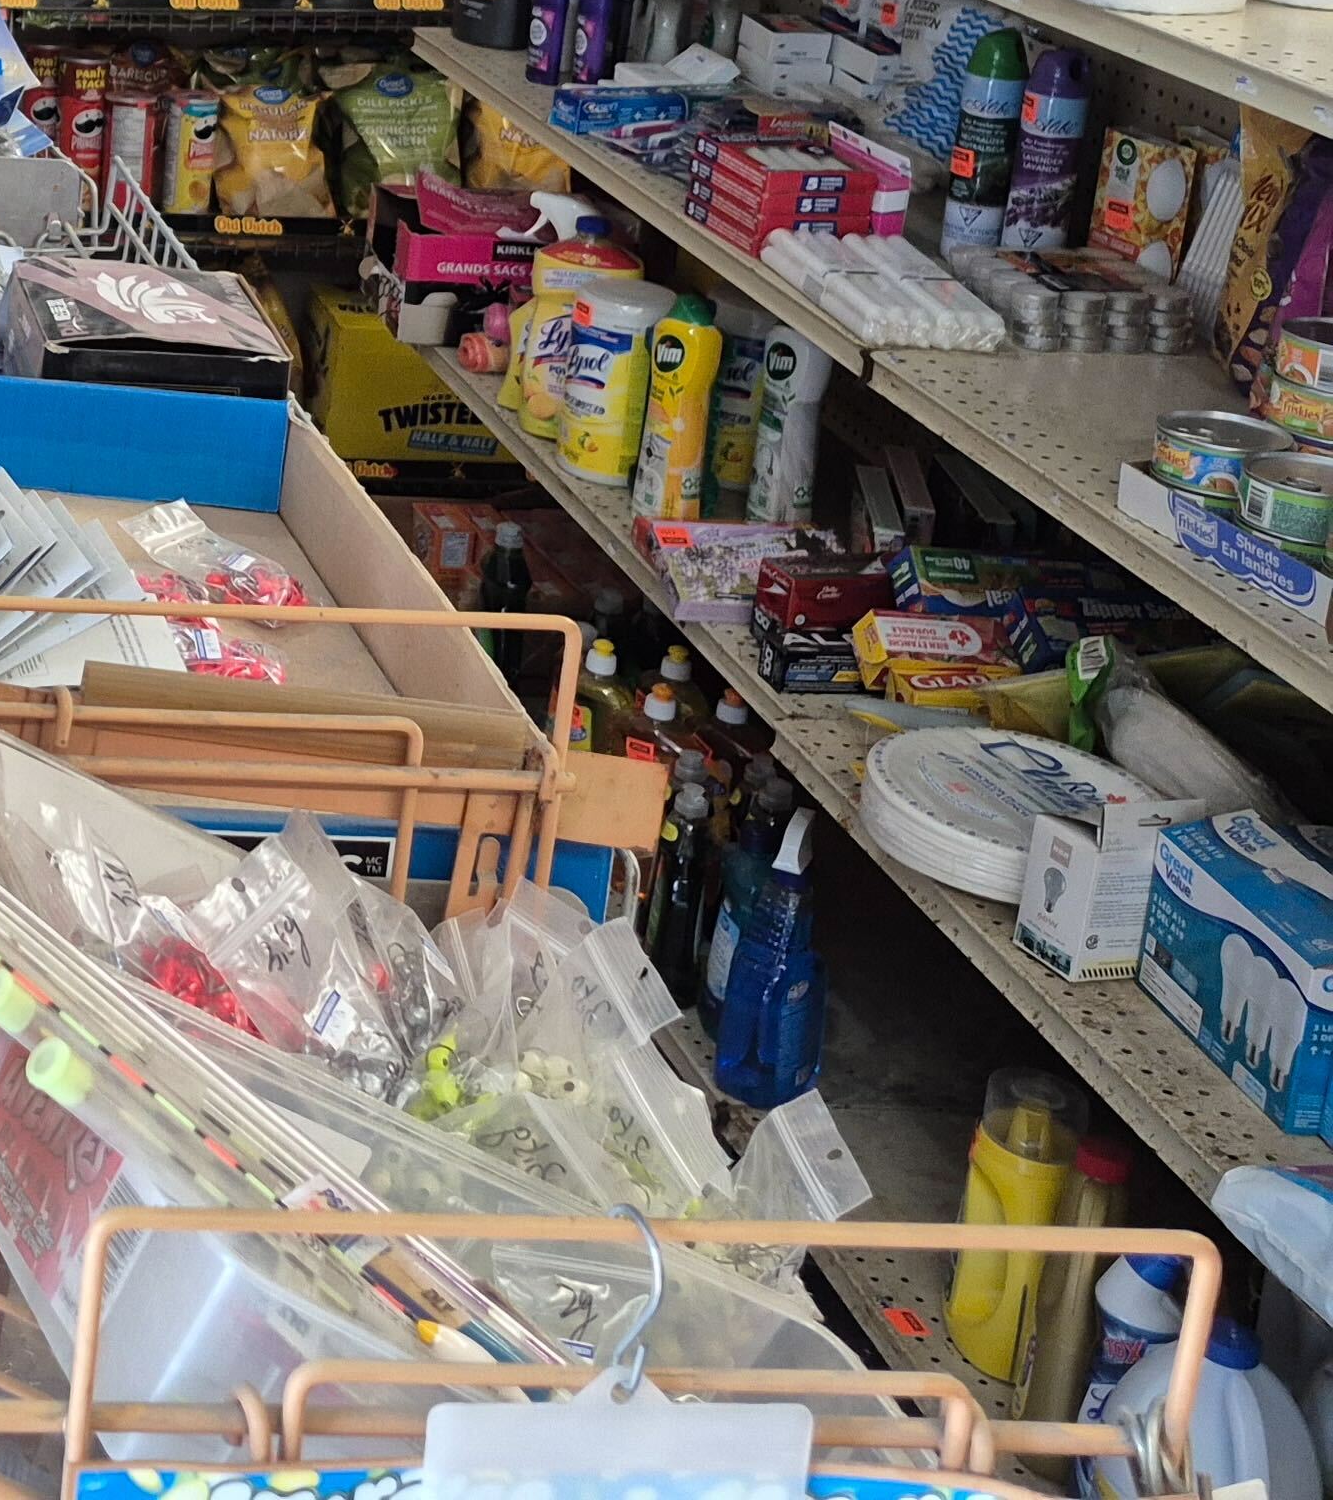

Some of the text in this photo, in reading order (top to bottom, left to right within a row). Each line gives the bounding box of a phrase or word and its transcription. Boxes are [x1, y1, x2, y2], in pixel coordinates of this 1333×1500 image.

[75, 67, 105, 79] PARTY
[215, 215, 282, 235] Old Dutch
[437, 262, 527, 276] GRANDS SACS
[568, 346, 608, 374] Lysol
[655, 342, 683, 364] Vim
[769, 351, 794, 371] Vim
[1178, 511, 1216, 542] Friskies
[1236, 533, 1280, 567] Shreds
[1222, 540, 1293, 592] En lanières
[911, 673, 987, 690] GLAD
[365, 856, 383, 866] MC
[366, 866, 381, 875] TM
[1160, 844, 1194, 884] Great
[1165, 865, 1192, 897] Value
